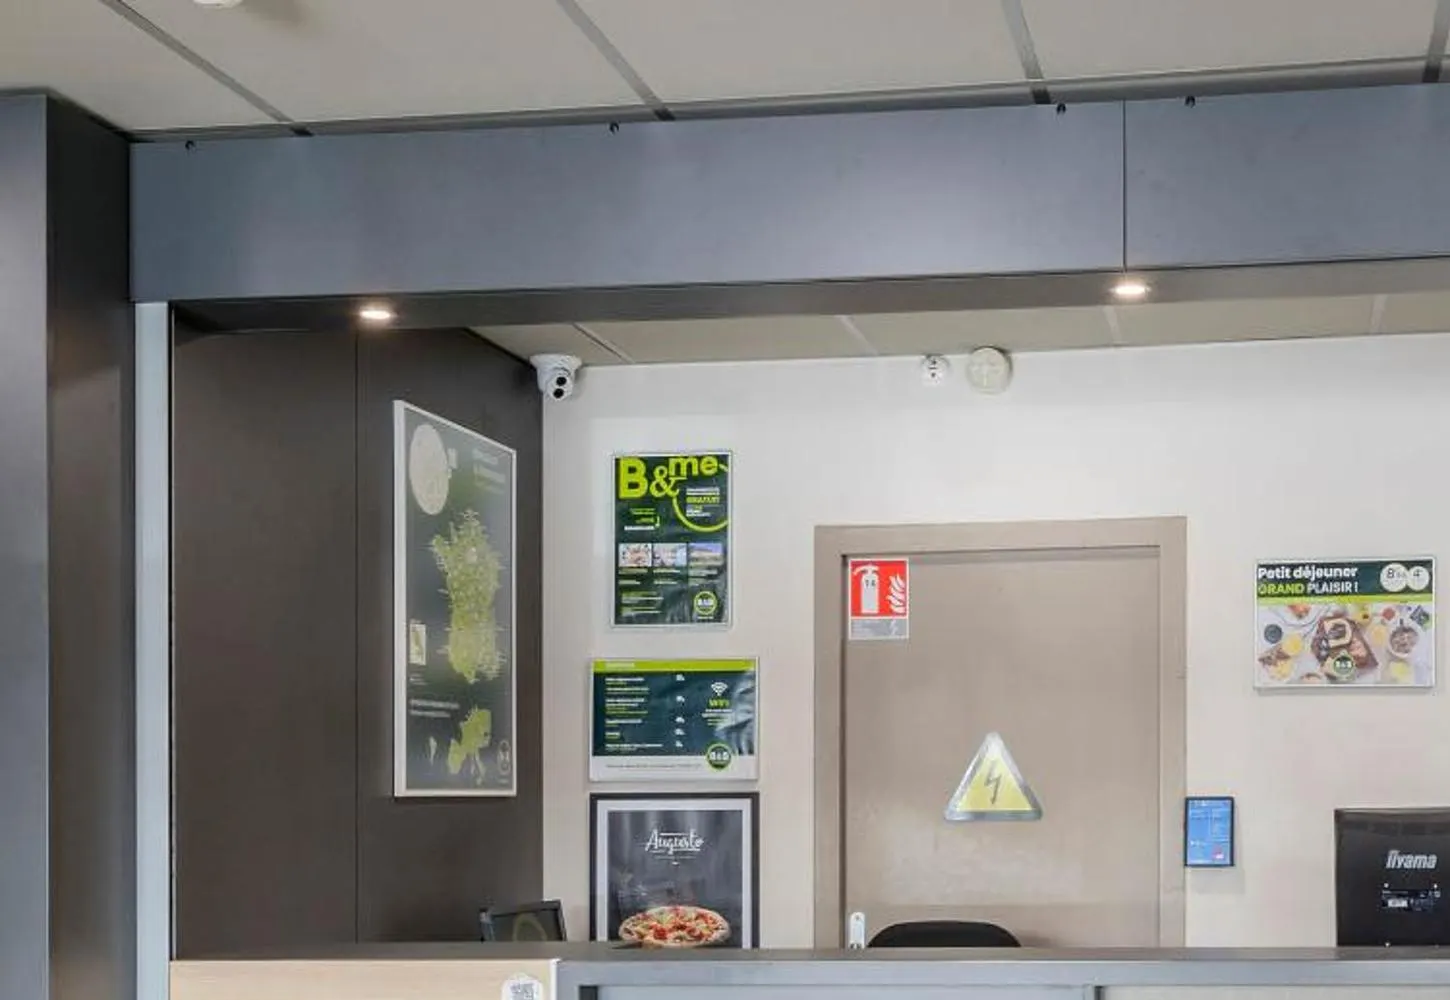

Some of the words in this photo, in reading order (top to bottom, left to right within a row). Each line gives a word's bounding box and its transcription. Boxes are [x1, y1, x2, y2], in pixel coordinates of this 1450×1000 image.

[1258, 566, 1291, 579] Petit
[1293, 565, 1358, 581] déjeuner
[1258, 583, 1305, 595] GRAND
[1307, 581, 1352, 594] PLAISIR
